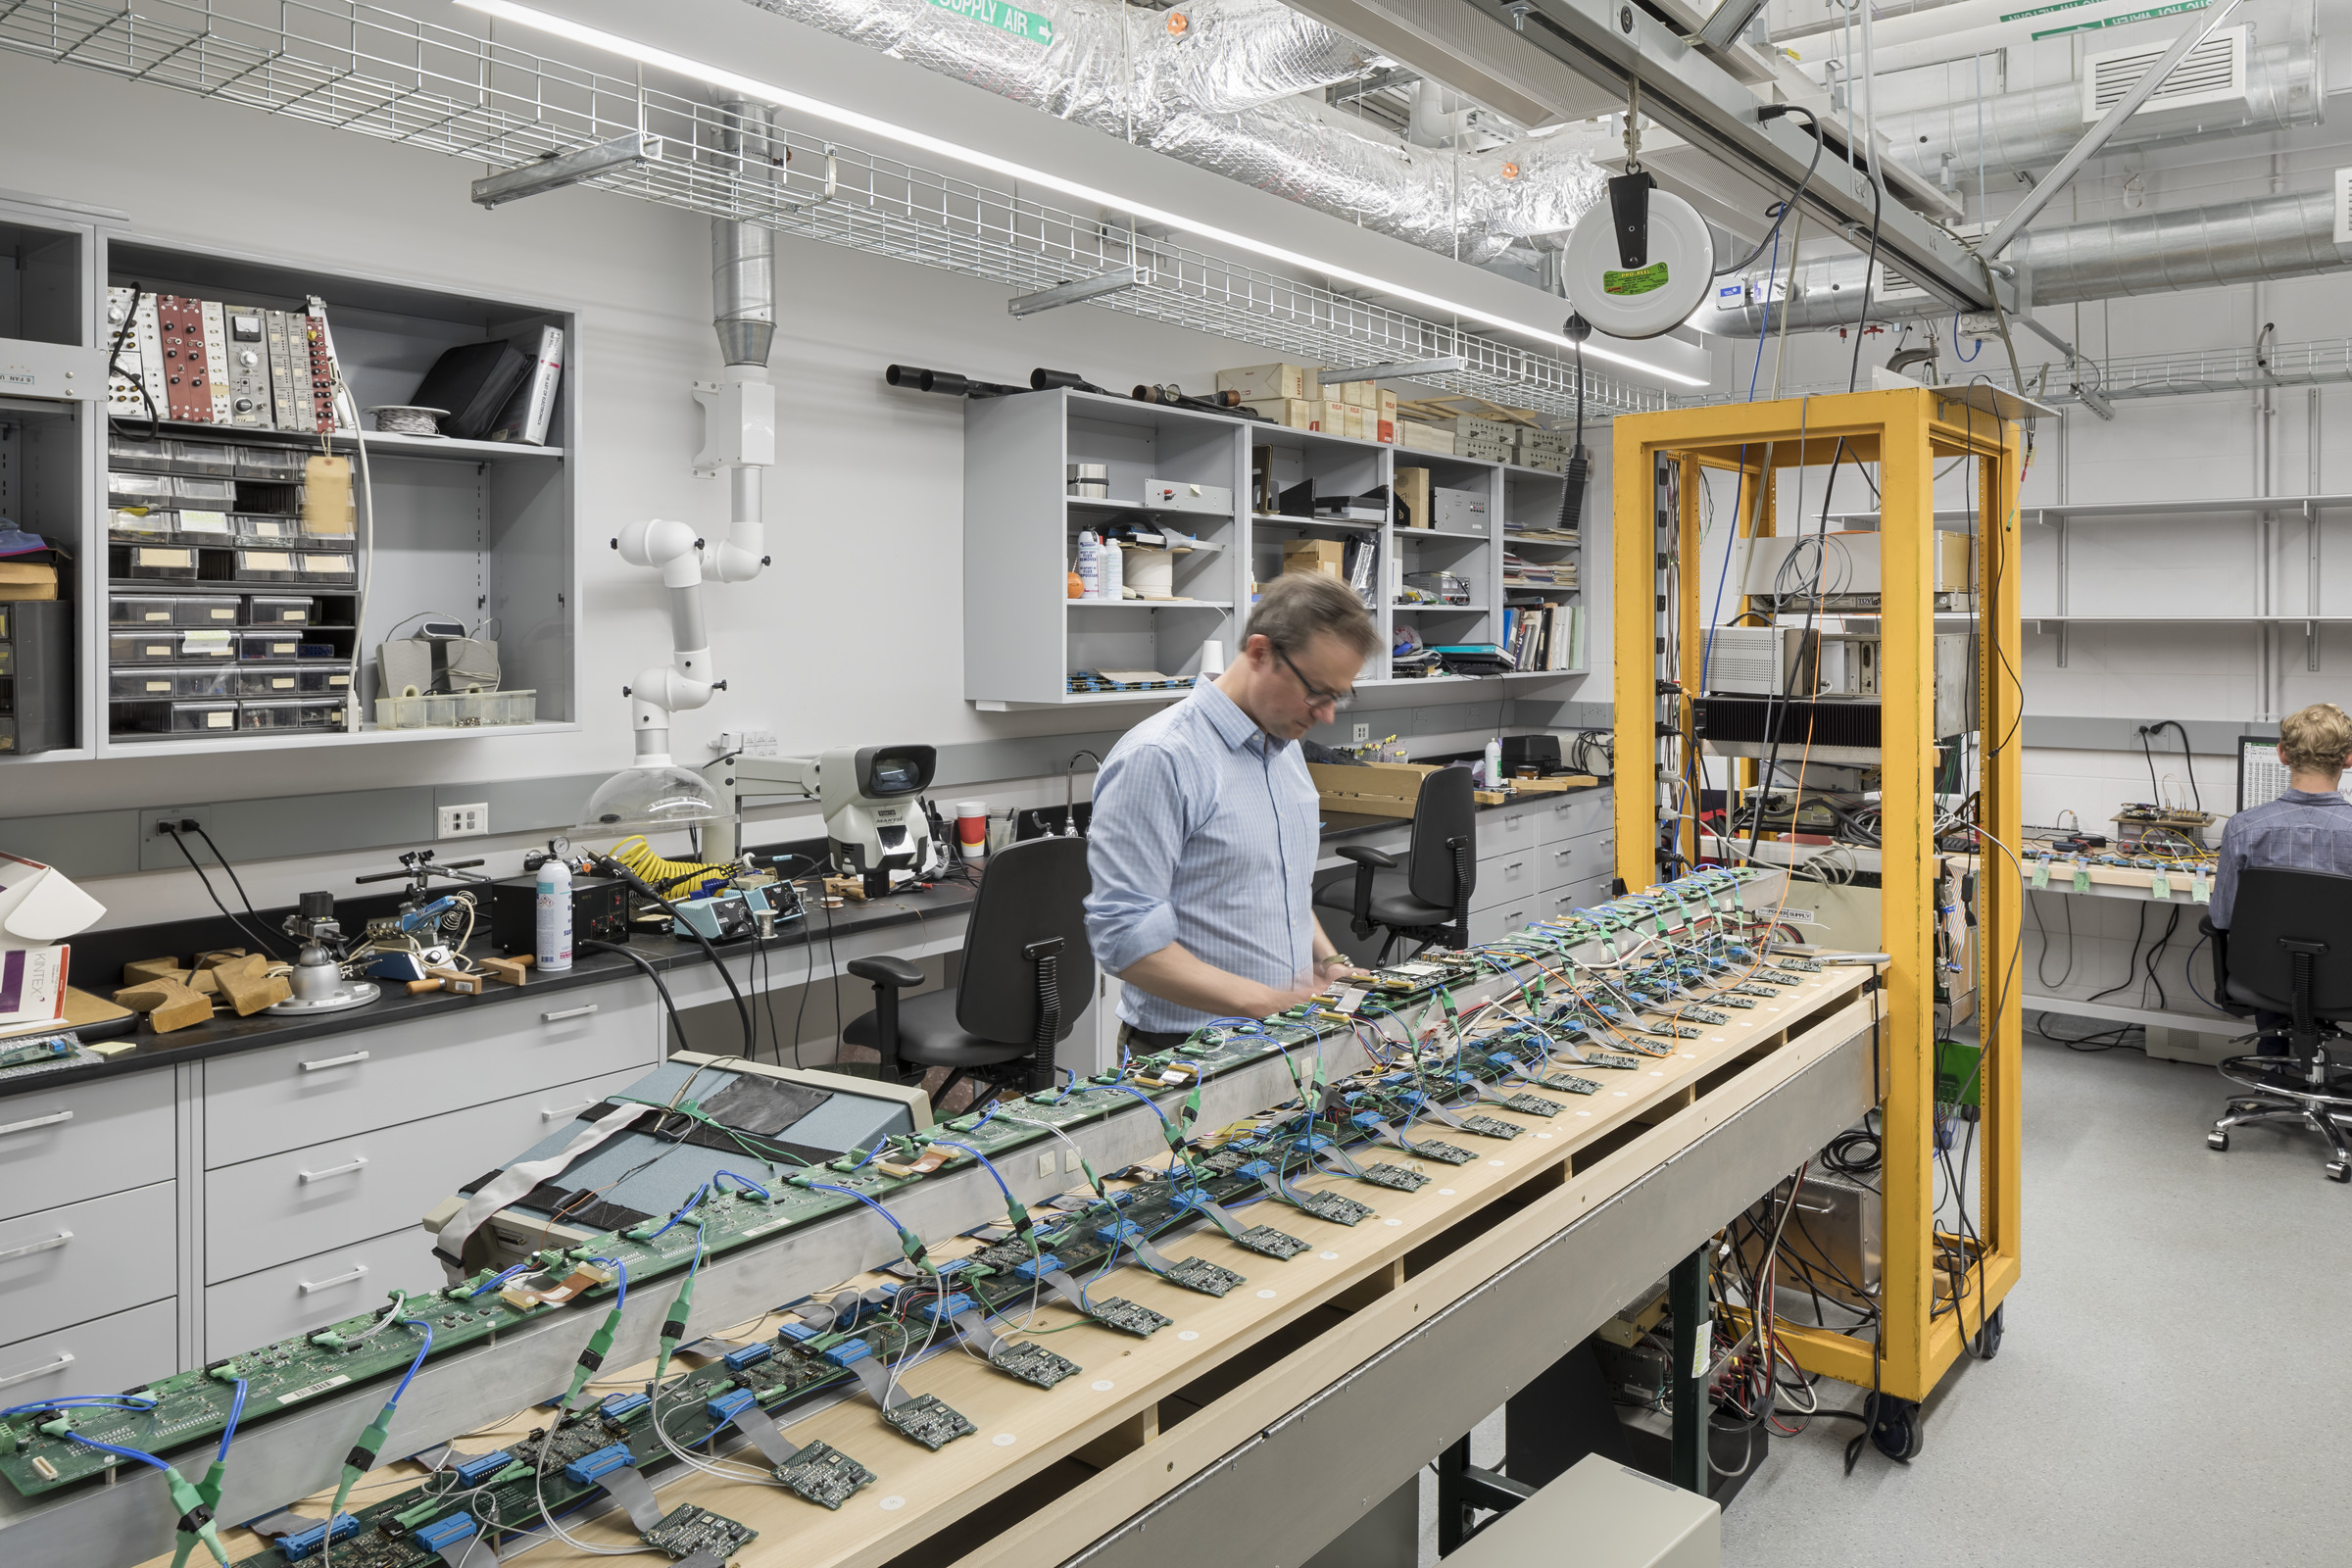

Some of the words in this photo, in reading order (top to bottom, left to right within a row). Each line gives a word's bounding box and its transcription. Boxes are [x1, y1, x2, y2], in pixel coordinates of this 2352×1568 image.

[1003, 8, 1028, 36] AIR
[2159, 5, 2181, 17] HOT
[537, 397, 547, 425] ELECTRONICS
[1385, 401, 1396, 410] RCA
[30, 953, 46, 995] KINTEX
